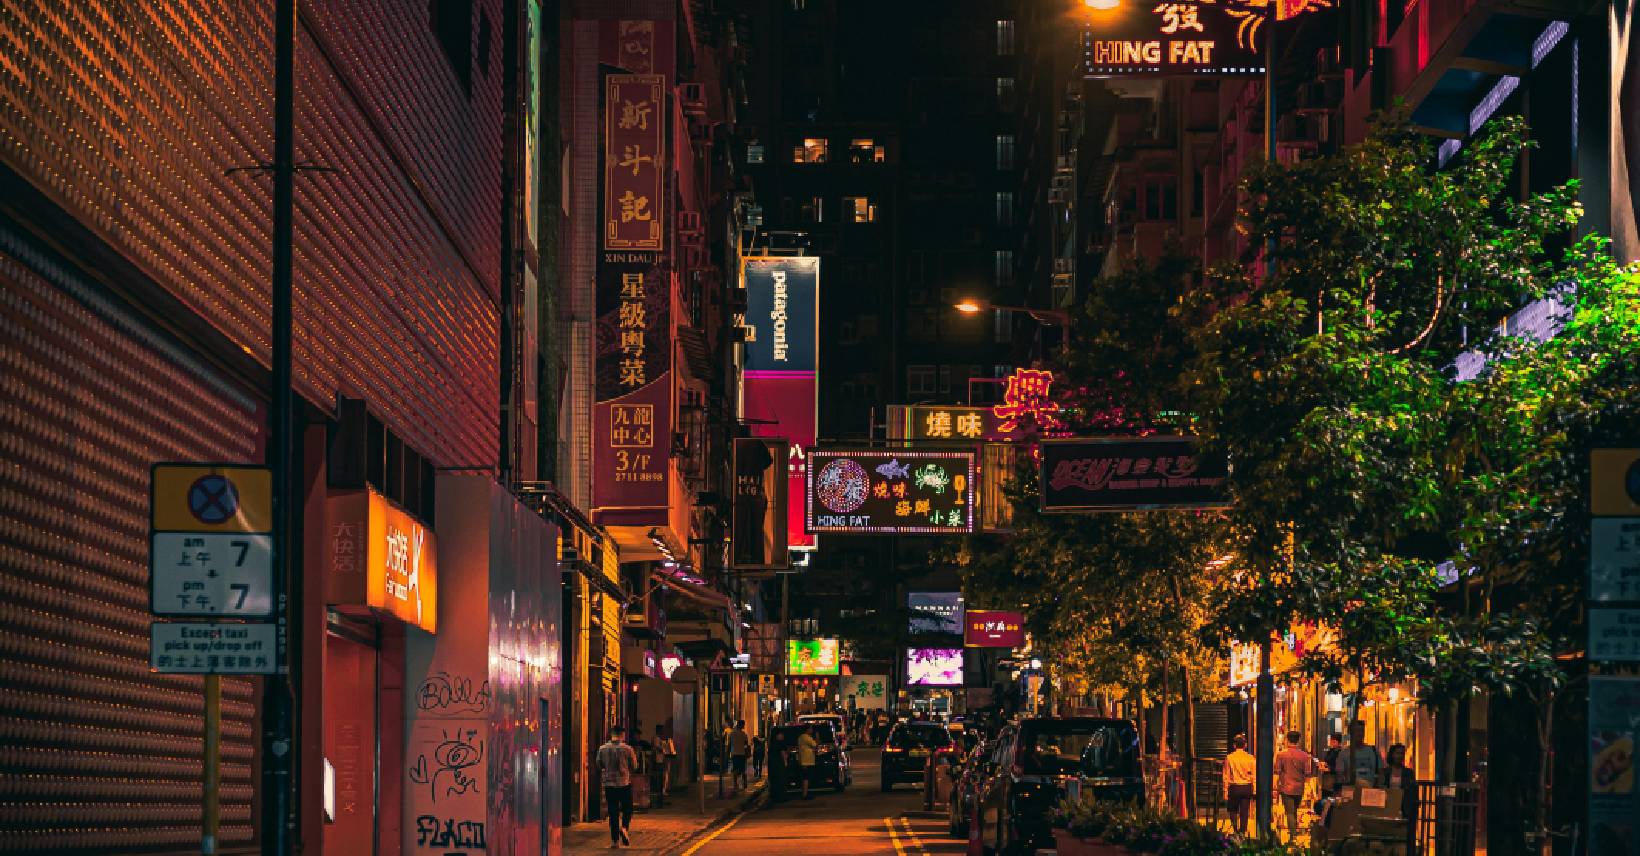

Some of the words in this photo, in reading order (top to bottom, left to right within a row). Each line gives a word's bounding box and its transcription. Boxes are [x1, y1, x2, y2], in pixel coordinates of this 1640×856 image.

[1095, 41, 1160, 63] HING
[1169, 41, 1215, 63] FAT
[617, 100, 652, 223] 新斗記
[605, 253, 625, 264] XIN
[771, 271, 788, 362] patagonia
[620, 272, 646, 386] 星級粵菜
[614, 407, 651, 425] 九龍
[926, 411, 982, 439] 燒味
[614, 428, 651, 444] 中心
[615, 450, 651, 472] 3/F
[818, 515, 845, 526] HING
[849, 515, 870, 526] FAT
[183, 538, 205, 548] am
[176, 551, 211, 566] 上午
[230, 540, 249, 567] 7
[183, 581, 205, 592] pm
[176, 594, 211, 609] 下午
[230, 583, 249, 609] 7
[181, 627, 222, 639] Except
[225, 627, 248, 639] taxi
[164, 640, 190, 651] pick
[193, 640, 242, 652] up/drop
[244, 640, 263, 651] off
